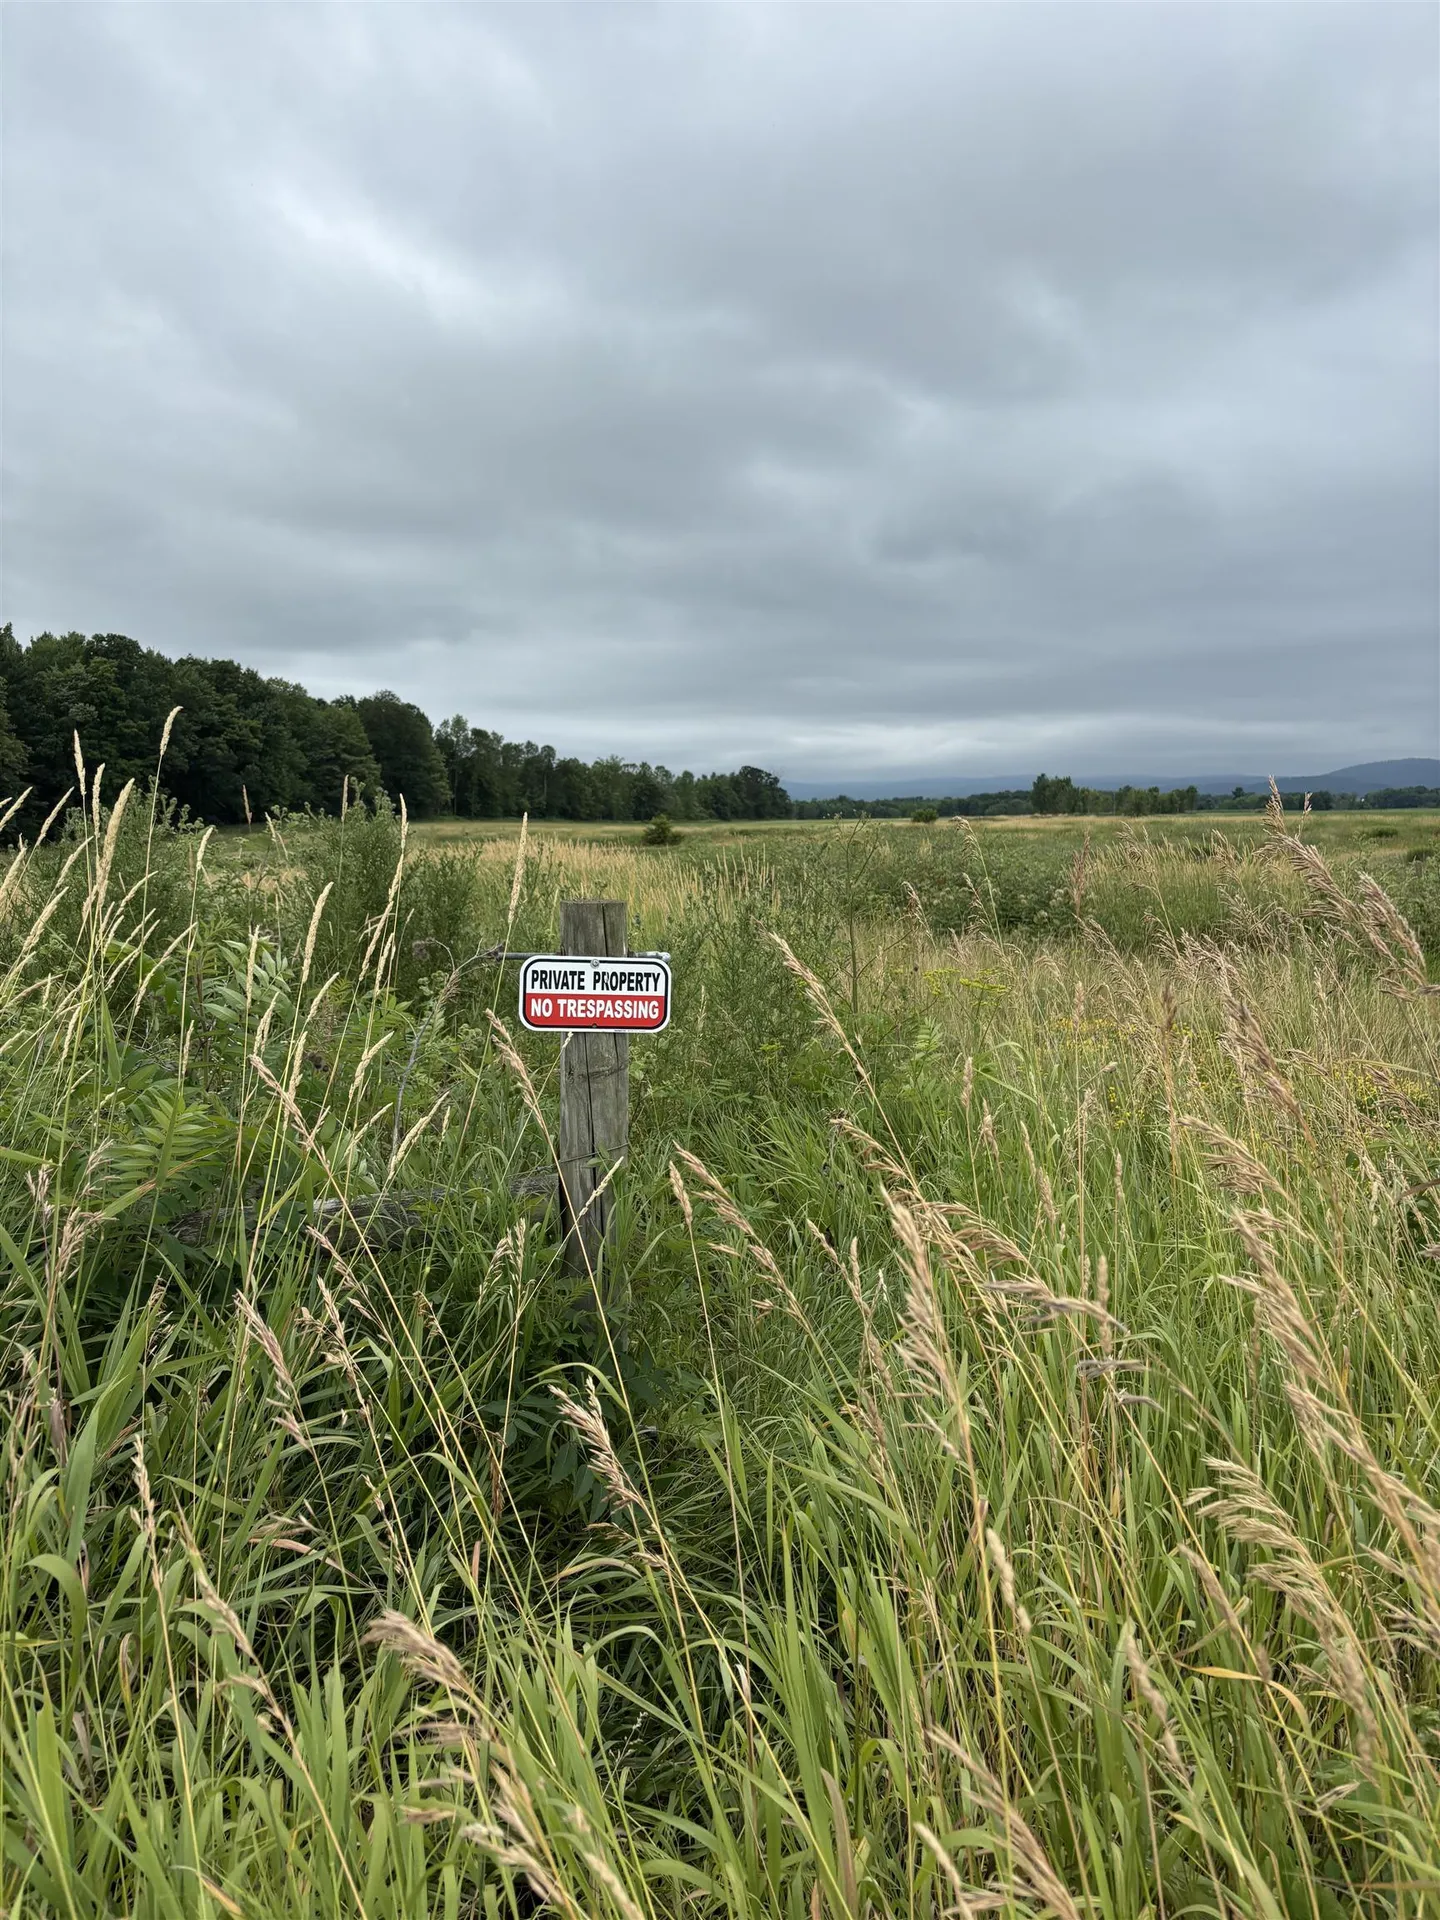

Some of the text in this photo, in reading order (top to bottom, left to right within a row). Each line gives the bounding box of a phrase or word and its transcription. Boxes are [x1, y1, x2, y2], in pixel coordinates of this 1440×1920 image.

[531, 969, 661, 992] PRIVATE PROPERTY
[531, 998, 659, 1019] NO TRESPASSING
